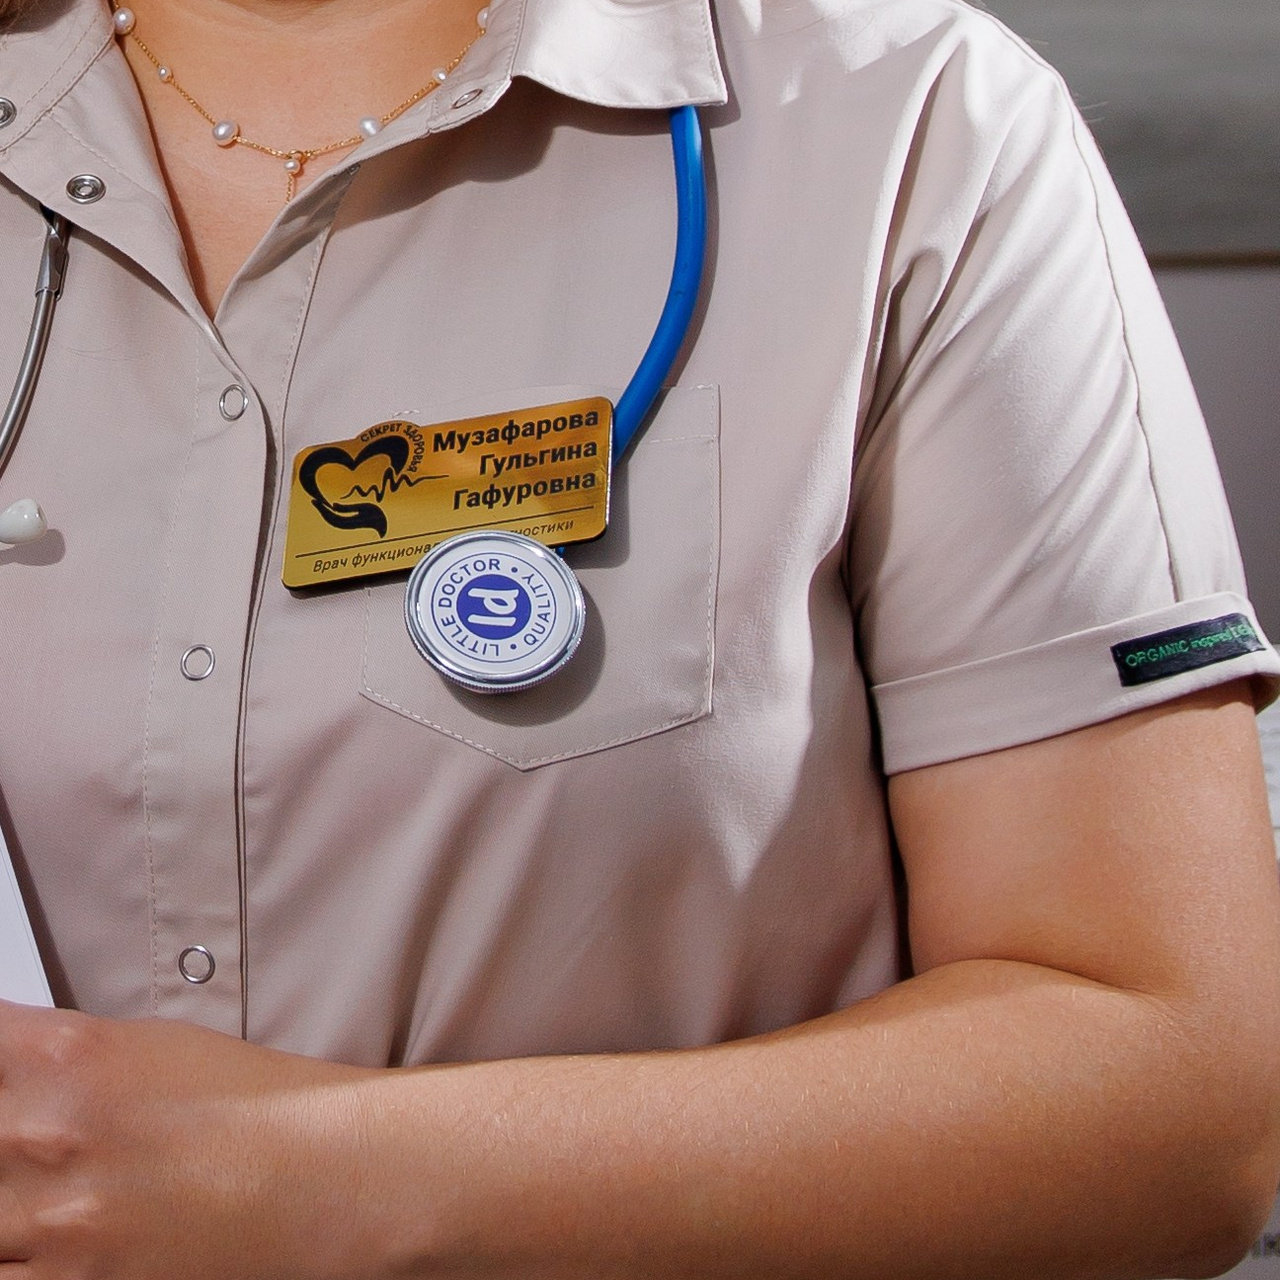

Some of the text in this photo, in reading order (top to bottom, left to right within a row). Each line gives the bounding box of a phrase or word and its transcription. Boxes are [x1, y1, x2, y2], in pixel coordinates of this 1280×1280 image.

[361, 423, 425, 472] СЕКРЕТ ЗДОРОВЬЯ
[433, 410, 599, 453] Музафарова
[479, 441, 598, 478] Гульгина
[453, 472, 596, 510] Гафуровна
[312, 558, 348, 574] Врач
[438, 558, 501, 656] LITTLE DOCTOR
[522, 573, 551, 646] QUALITY
[1125, 640, 1189, 667] ORGANIC
